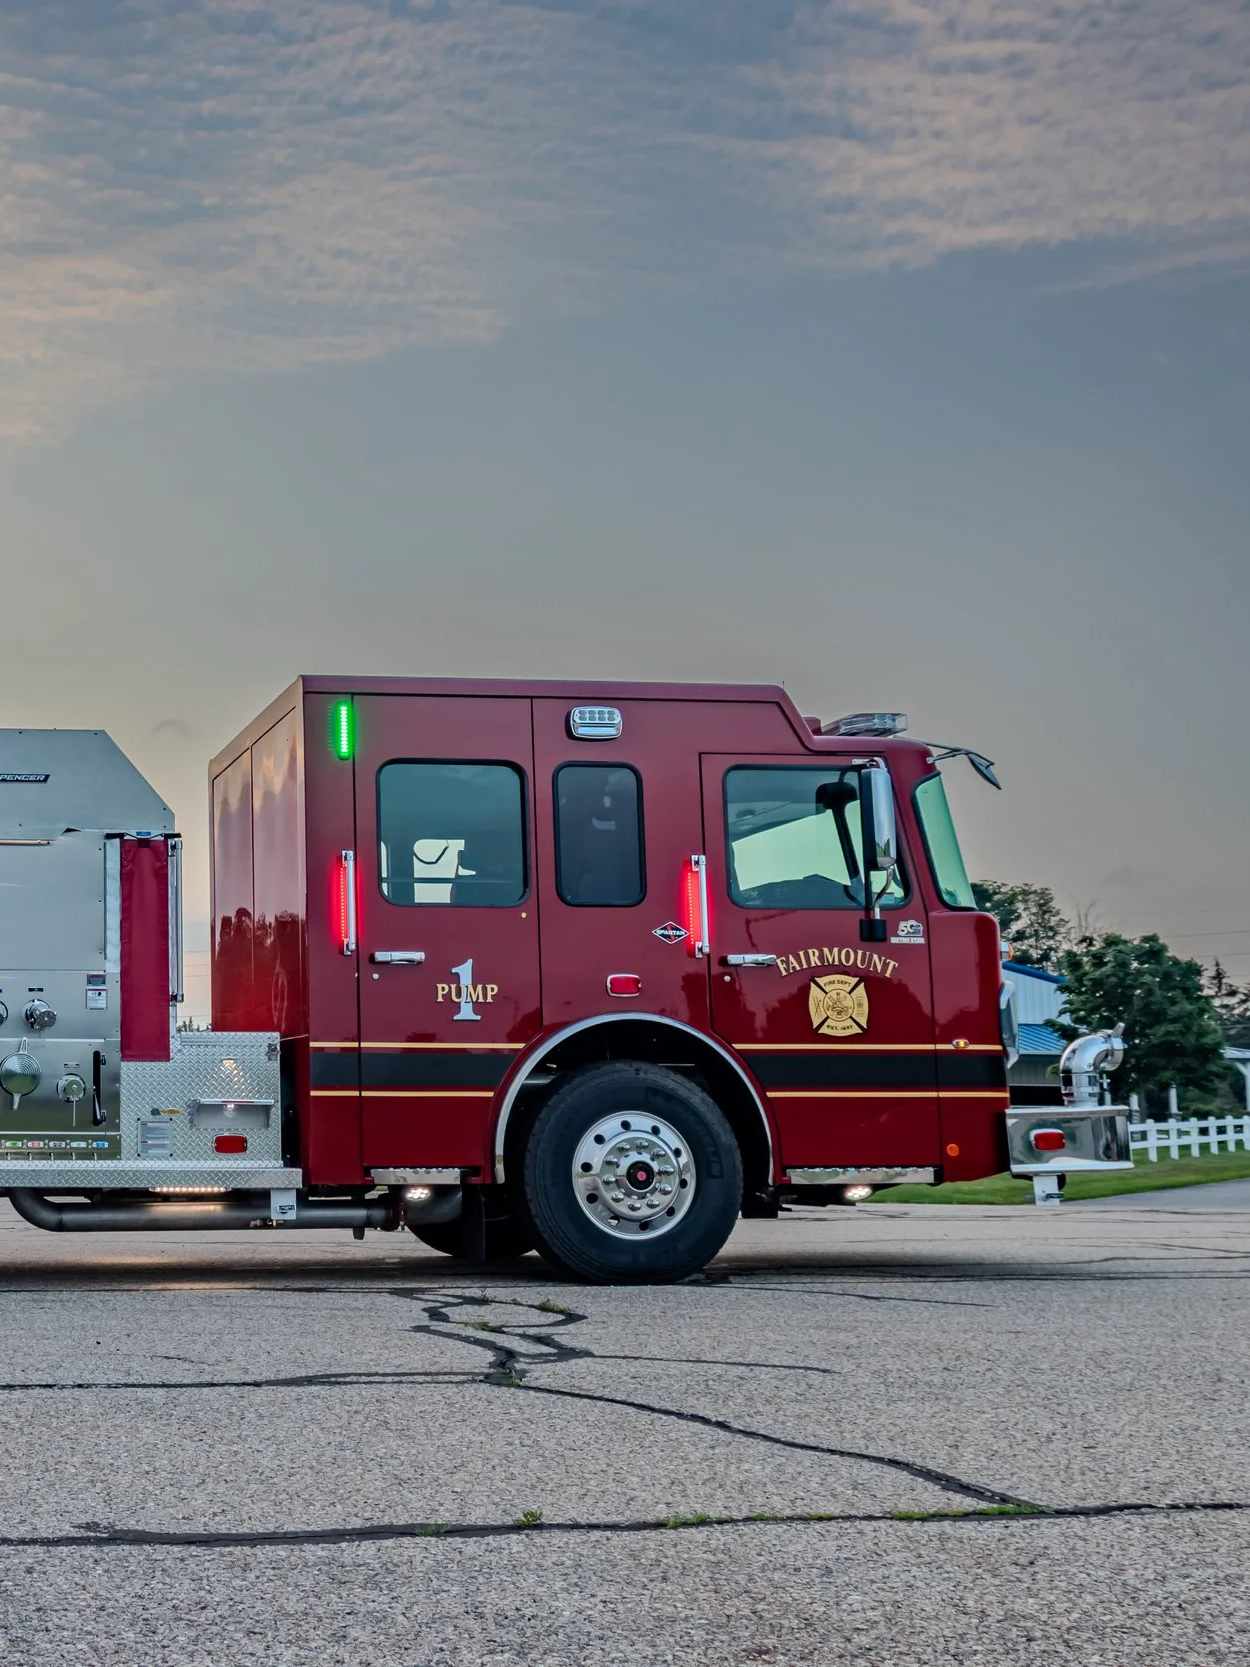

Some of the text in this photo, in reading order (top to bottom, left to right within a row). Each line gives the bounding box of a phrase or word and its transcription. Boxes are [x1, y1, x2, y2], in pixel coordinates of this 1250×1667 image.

[776, 947, 898, 978] FAIRMOUNT
[436, 983, 499, 1003] PUMP
[451, 958, 482, 1020] 1
[823, 979, 835, 987] FIRE
